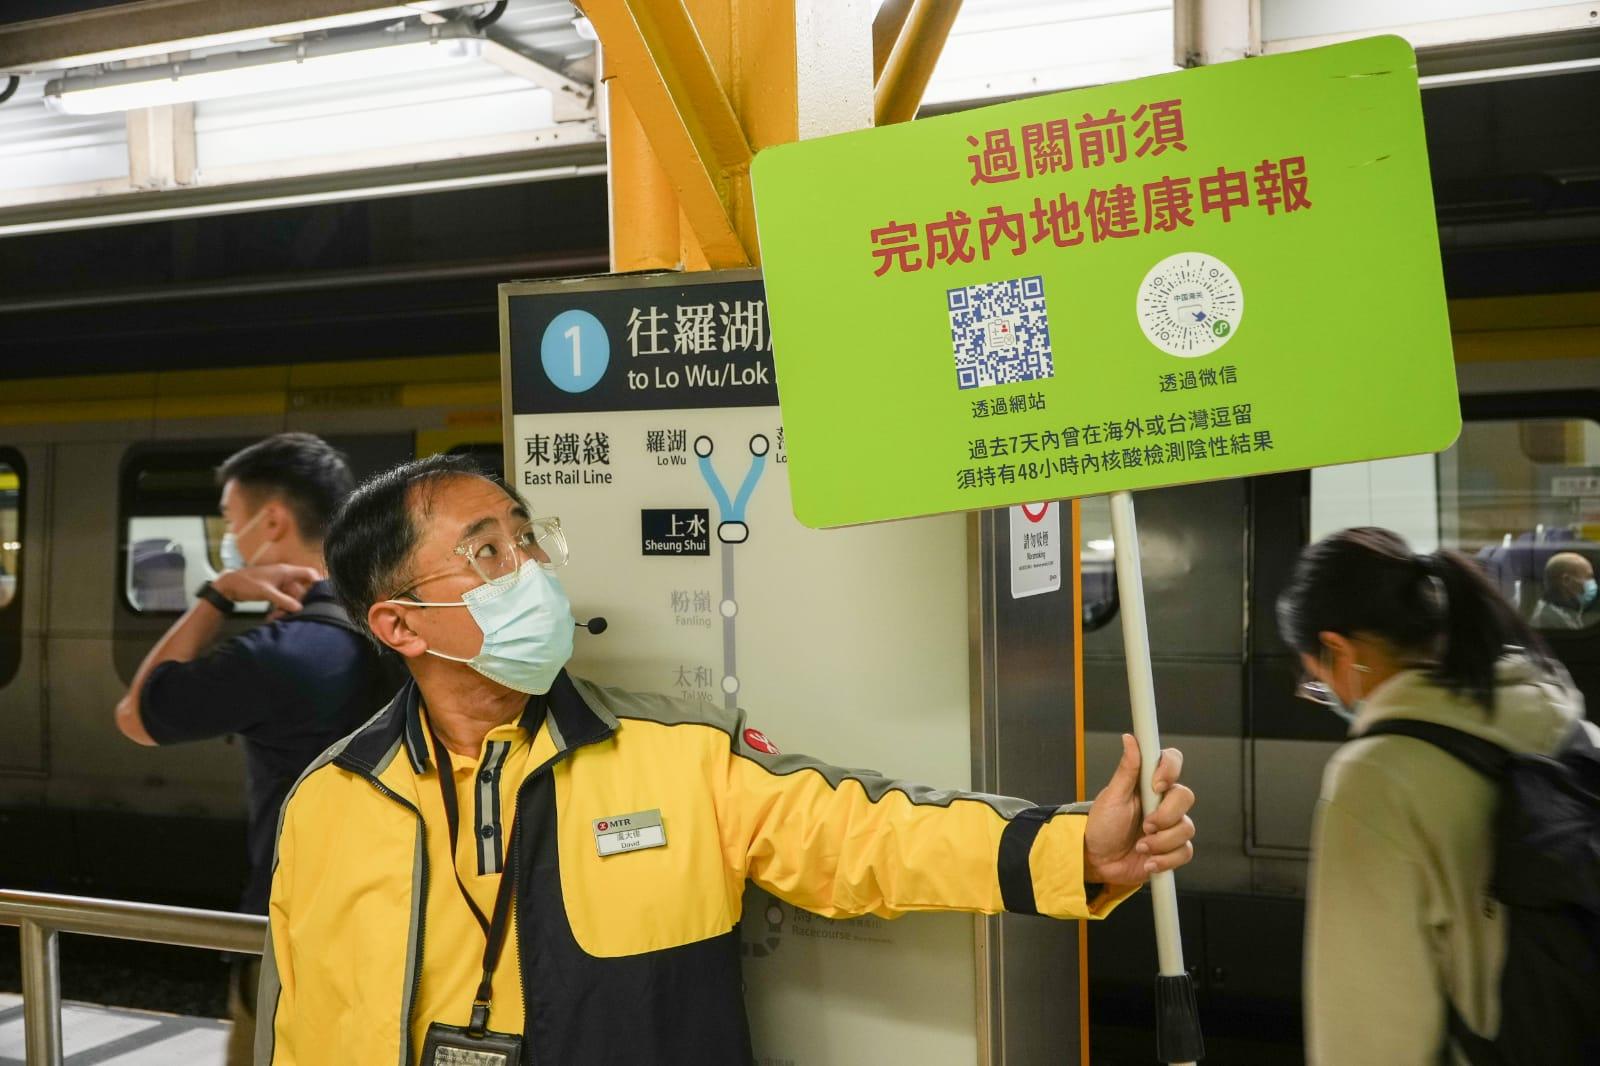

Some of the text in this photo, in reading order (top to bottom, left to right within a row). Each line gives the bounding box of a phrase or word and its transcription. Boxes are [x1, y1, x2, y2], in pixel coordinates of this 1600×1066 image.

[967, 99, 1187, 186] 過關前須
[870, 156, 1313, 277] 完成內地健康申報
[627, 300, 772, 357] 往羅湖
[563, 325, 582, 377] 1
[627, 361, 769, 390] to Lo Wu/Lok
[1159, 365, 1237, 393] 透過微信
[971, 391, 1046, 418] 透過網站
[646, 429, 687, 453] 羅湖
[968, 403, 1252, 460] 過去7天內曾在海外或台灣逗留
[524, 432, 610, 467] 東鐵綫
[657, 454, 687, 466] Lo Wu
[776, 453, 787, 463] Lo
[956, 430, 1274, 490] 須持有48小時內核酸檢測陰性結果
[524, 468, 613, 485] East Rail Line
[665, 514, 706, 538] 上水
[645, 538, 706, 553] Sheung Shui
[671, 590, 712, 613] 粉嶺
[675, 615, 712, 628] Fanling
[672, 664, 713, 688] 太和
[609, 818, 631, 828] MTR
[621, 841, 640, 849] David
